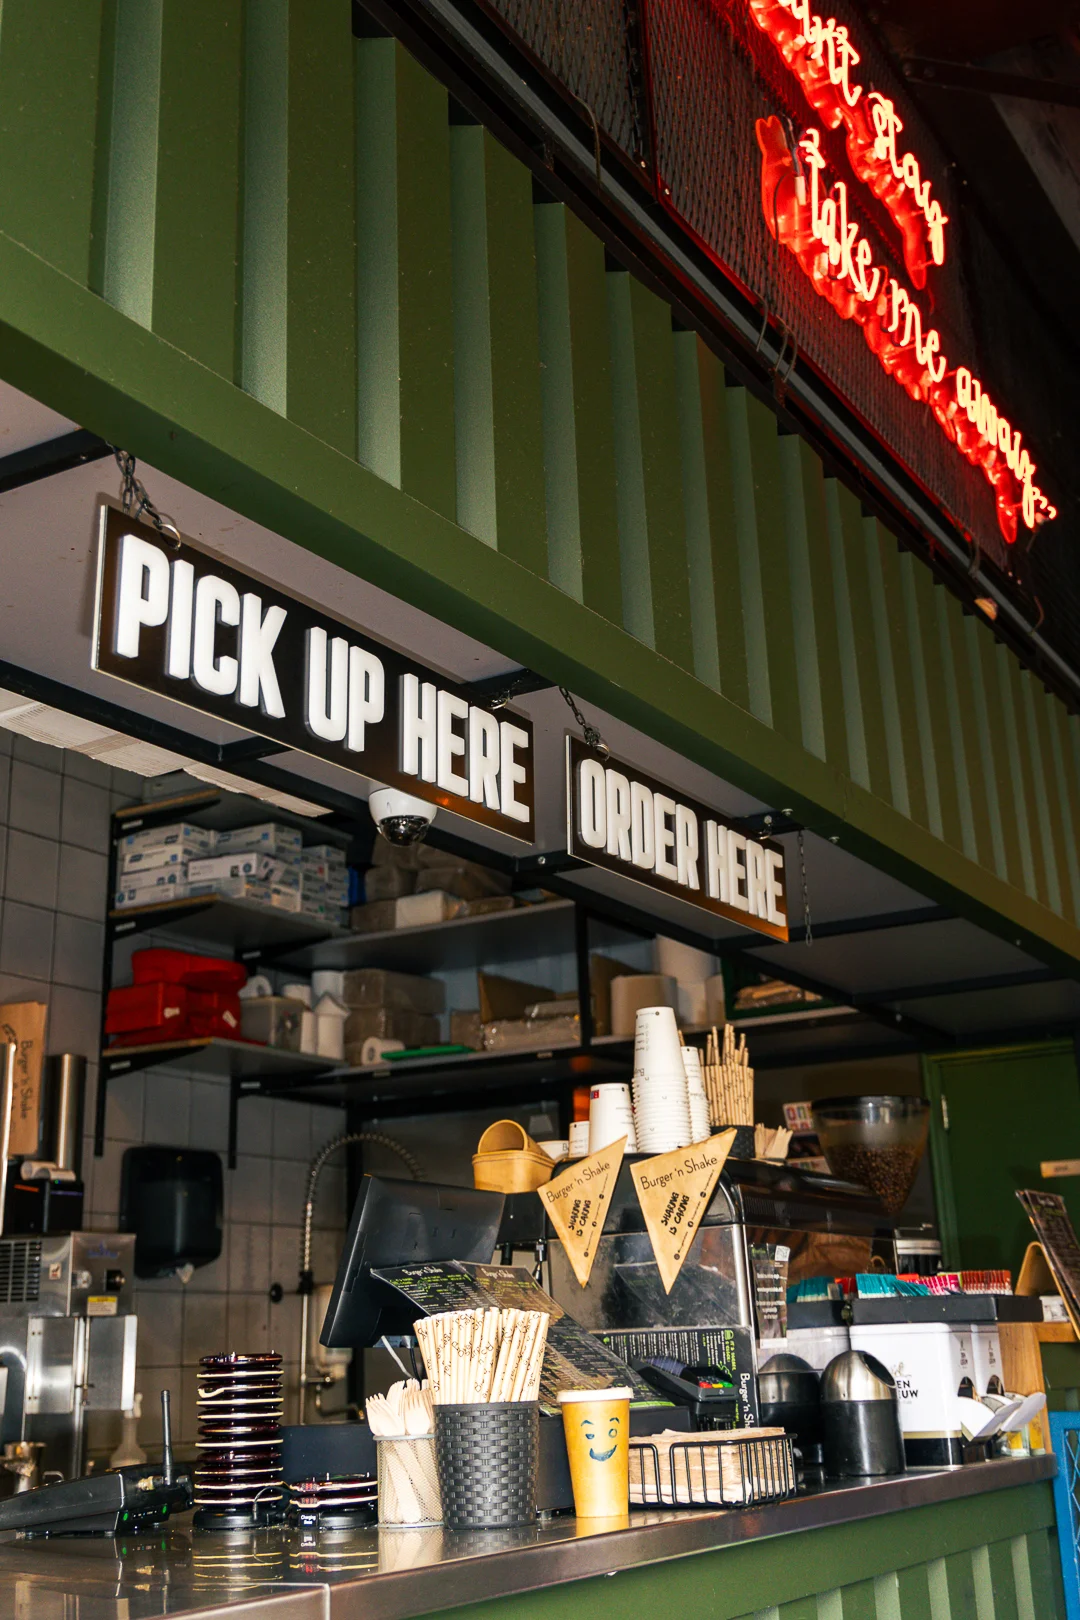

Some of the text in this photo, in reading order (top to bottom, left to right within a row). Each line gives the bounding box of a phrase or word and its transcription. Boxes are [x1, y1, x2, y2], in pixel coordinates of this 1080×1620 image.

[888, 279, 947, 383] me
[115, 534, 530, 823] PICK UP HERE
[579, 758, 787, 928] ORDER HERE
[546, 1184, 574, 1203] Burger
[582, 1161, 610, 1181] Shake
[640, 1172, 673, 1190] Burger
[684, 1154, 718, 1174] Shake
[568, 1199, 581, 1231] SHARING
[579, 1200, 592, 1227] CARING
[661, 1192, 680, 1226] SHARING
[669, 1226, 677, 1235] IS
[674, 1194, 690, 1224] CARING
[739, 1373, 751, 1403] Burger
